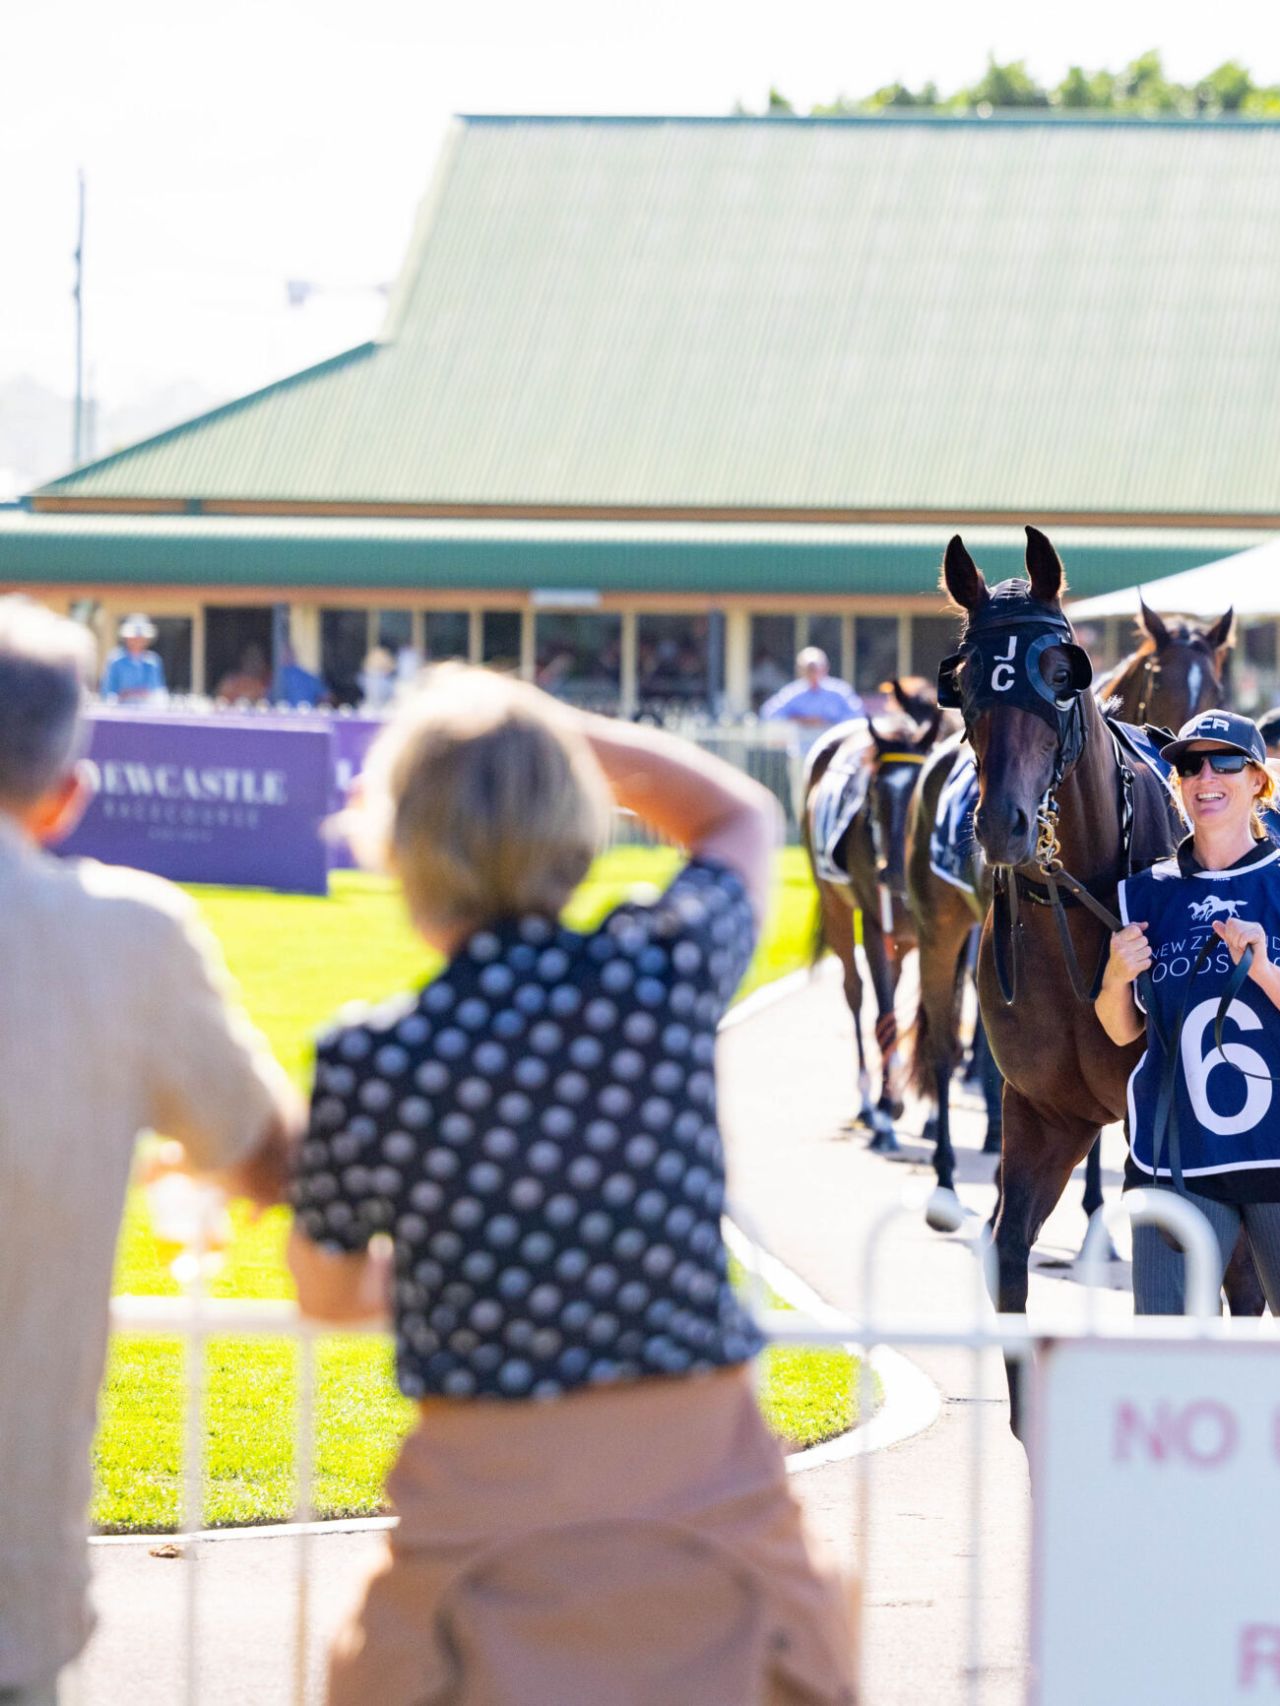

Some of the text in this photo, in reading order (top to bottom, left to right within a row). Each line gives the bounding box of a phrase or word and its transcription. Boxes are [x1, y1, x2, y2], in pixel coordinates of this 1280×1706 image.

[991, 663, 1015, 692] C
[88, 761, 287, 806] EWCASTLE
[1180, 997, 1273, 1136] 6
[1112, 1398, 1240, 1468] NO
